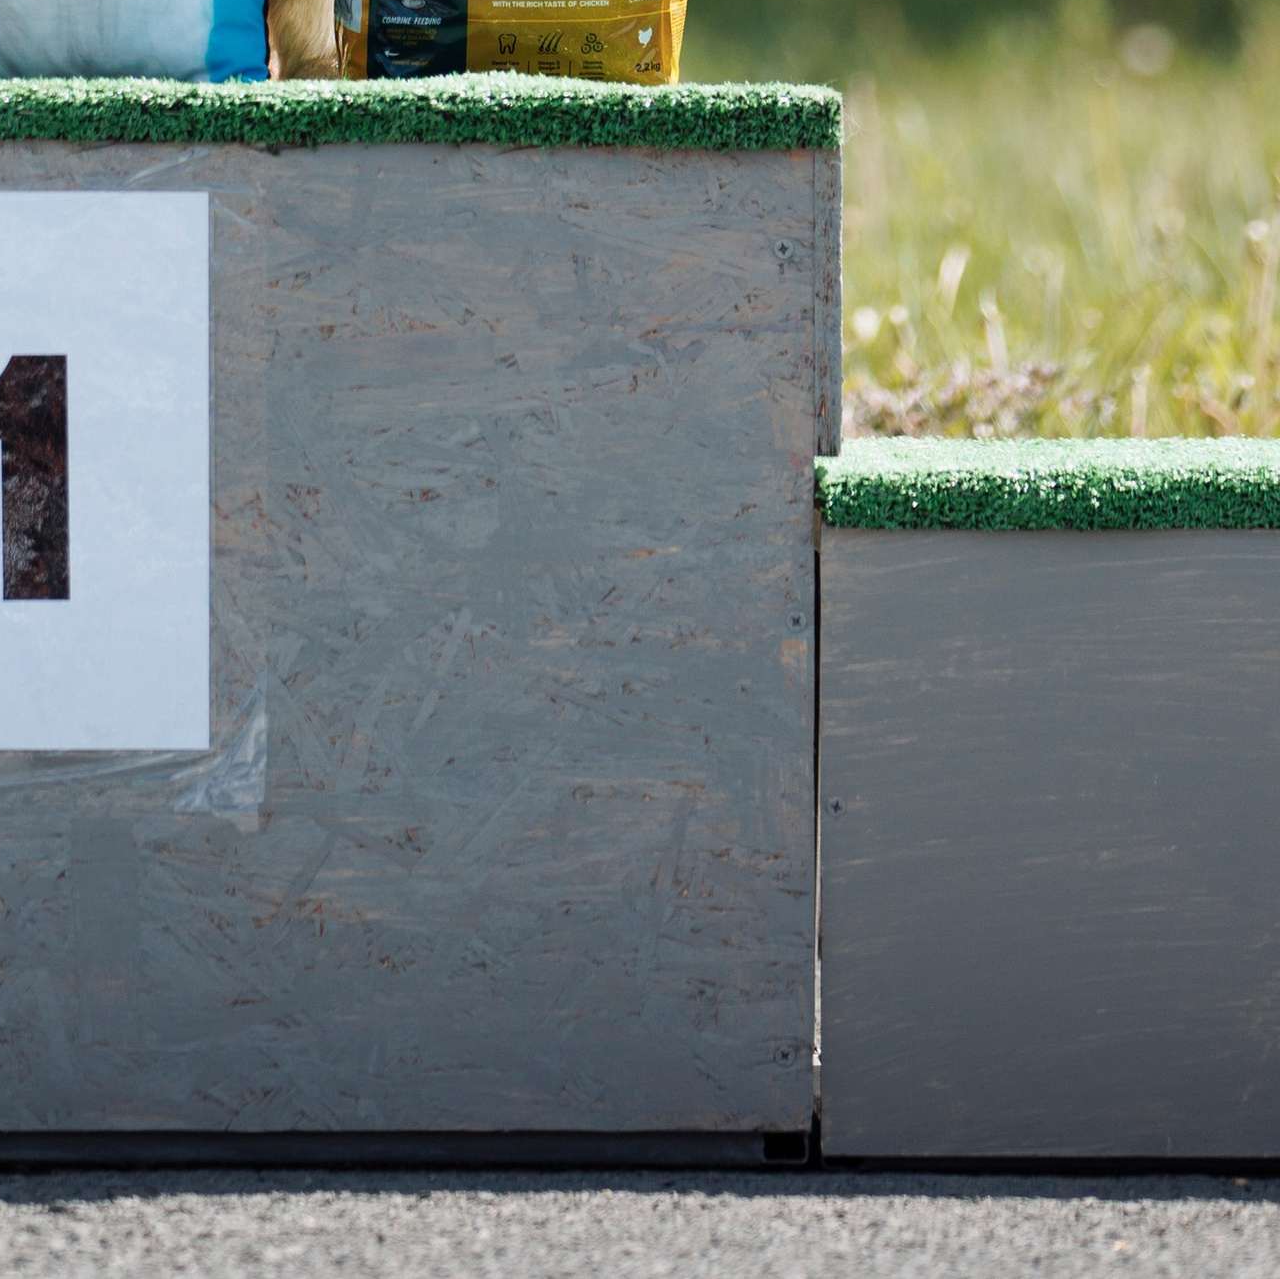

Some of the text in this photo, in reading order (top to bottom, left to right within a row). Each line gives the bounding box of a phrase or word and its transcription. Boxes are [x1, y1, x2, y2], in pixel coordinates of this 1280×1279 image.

[492, 0, 609, 9] WITH THE RICH TASTE OF CHICKEN
[381, 16, 442, 26] COMBINE FEEDING
